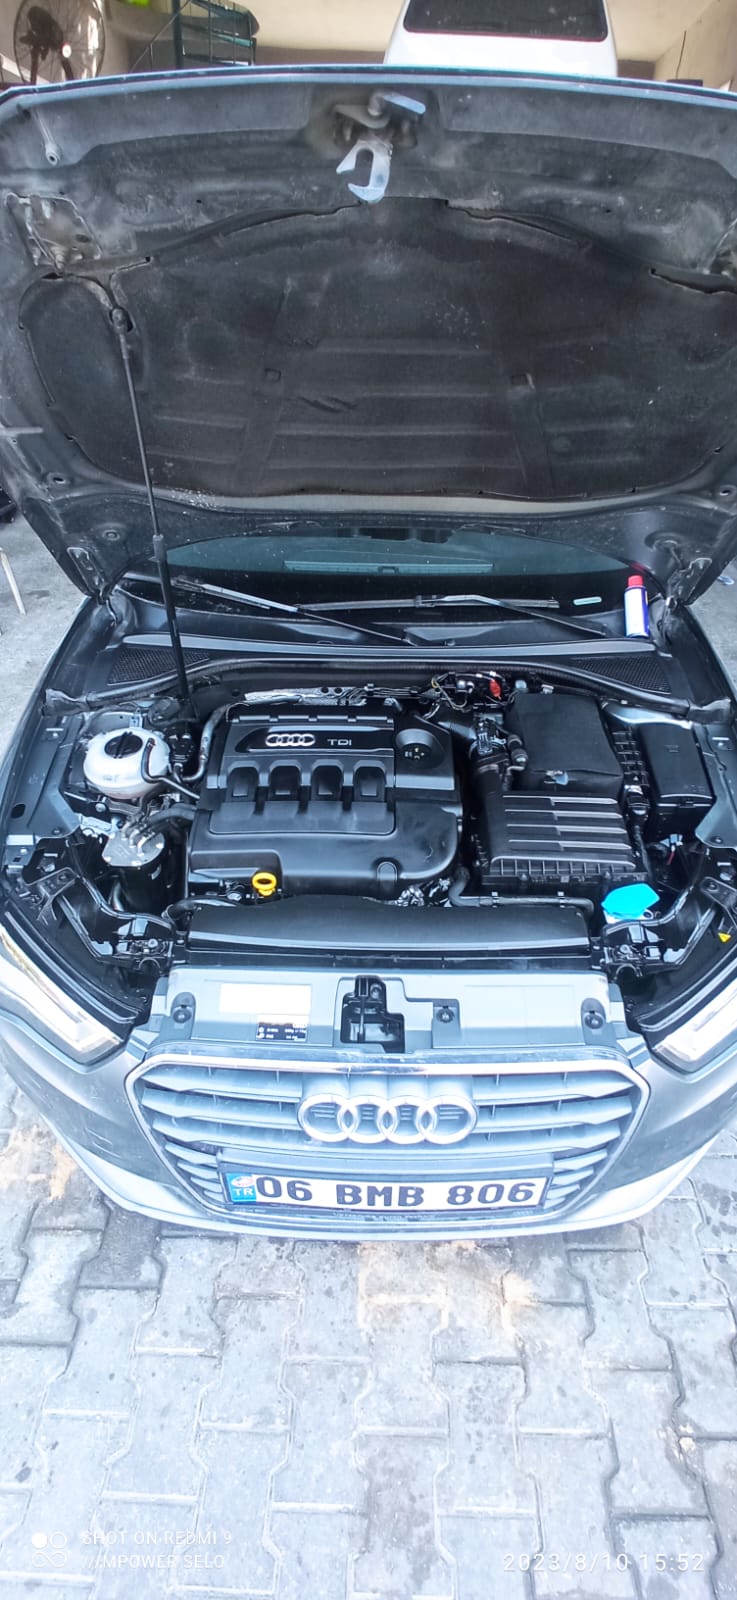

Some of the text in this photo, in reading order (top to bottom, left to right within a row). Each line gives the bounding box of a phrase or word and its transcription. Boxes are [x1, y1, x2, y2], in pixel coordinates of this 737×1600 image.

[327, 738, 352, 746] TDI
[233, 1187, 254, 1196] TR
[256, 1176, 537, 1207] 06 BMB 806
